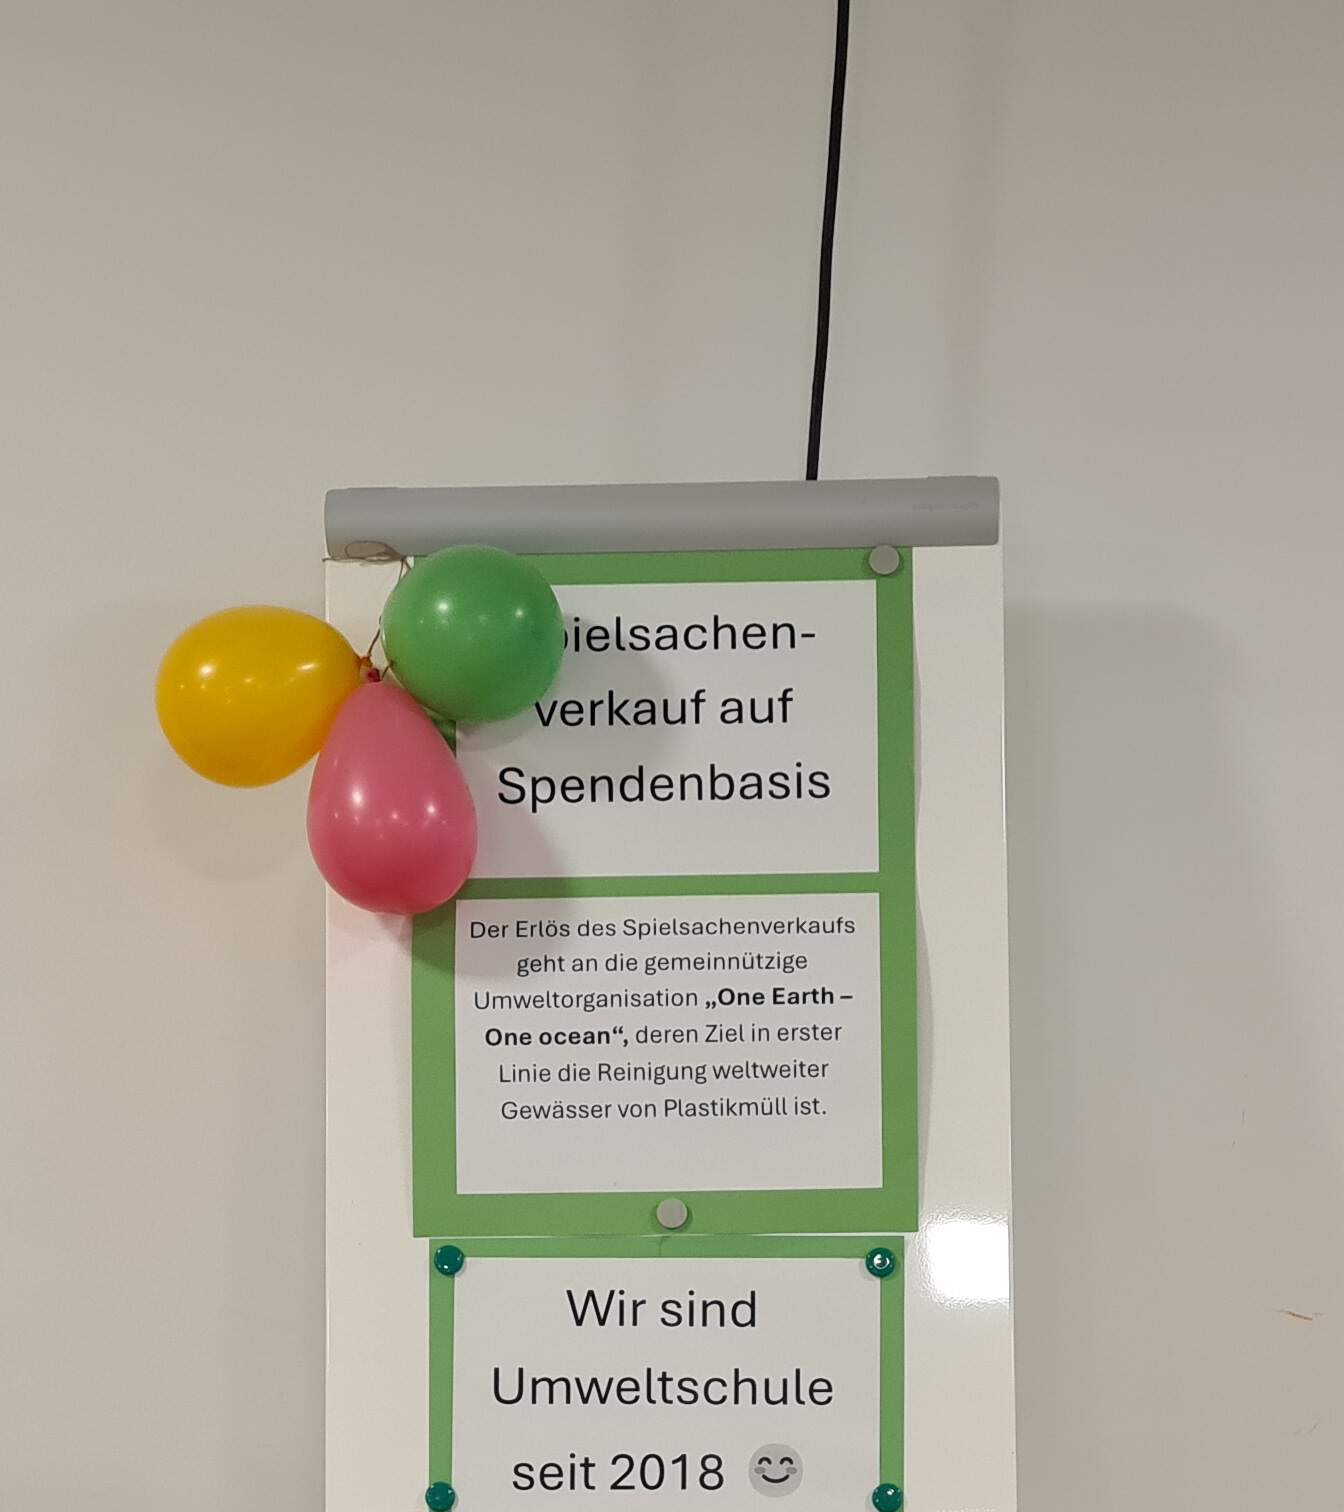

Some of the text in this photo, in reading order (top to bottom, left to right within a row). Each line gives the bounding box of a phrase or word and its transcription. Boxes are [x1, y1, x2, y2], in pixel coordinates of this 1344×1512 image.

[561, 614, 817, 654] ielsachen-
[535, 688, 795, 729] verkauf auf
[496, 761, 832, 814] Spendenbasis
[468, 915, 857, 940] Der Erlös des Spielsachenverkaufs
[515, 951, 809, 978] geht an die gemeinnützige
[473, 988, 700, 1012] Umweltorganisation
[704, 986, 767, 1010] „One
[771, 986, 835, 1007] Earth
[484, 1022, 844, 1050] One ocean“, deren Ziel in erster
[497, 1058, 830, 1085] Linie die Reinigung weltweiter
[500, 1096, 828, 1121] Gewässer von Plastikmüll ist.
[566, 1288, 758, 1328] Wir sind
[492, 1366, 835, 1407] Umweltschule
[511, 1452, 726, 1492] seit 2018
